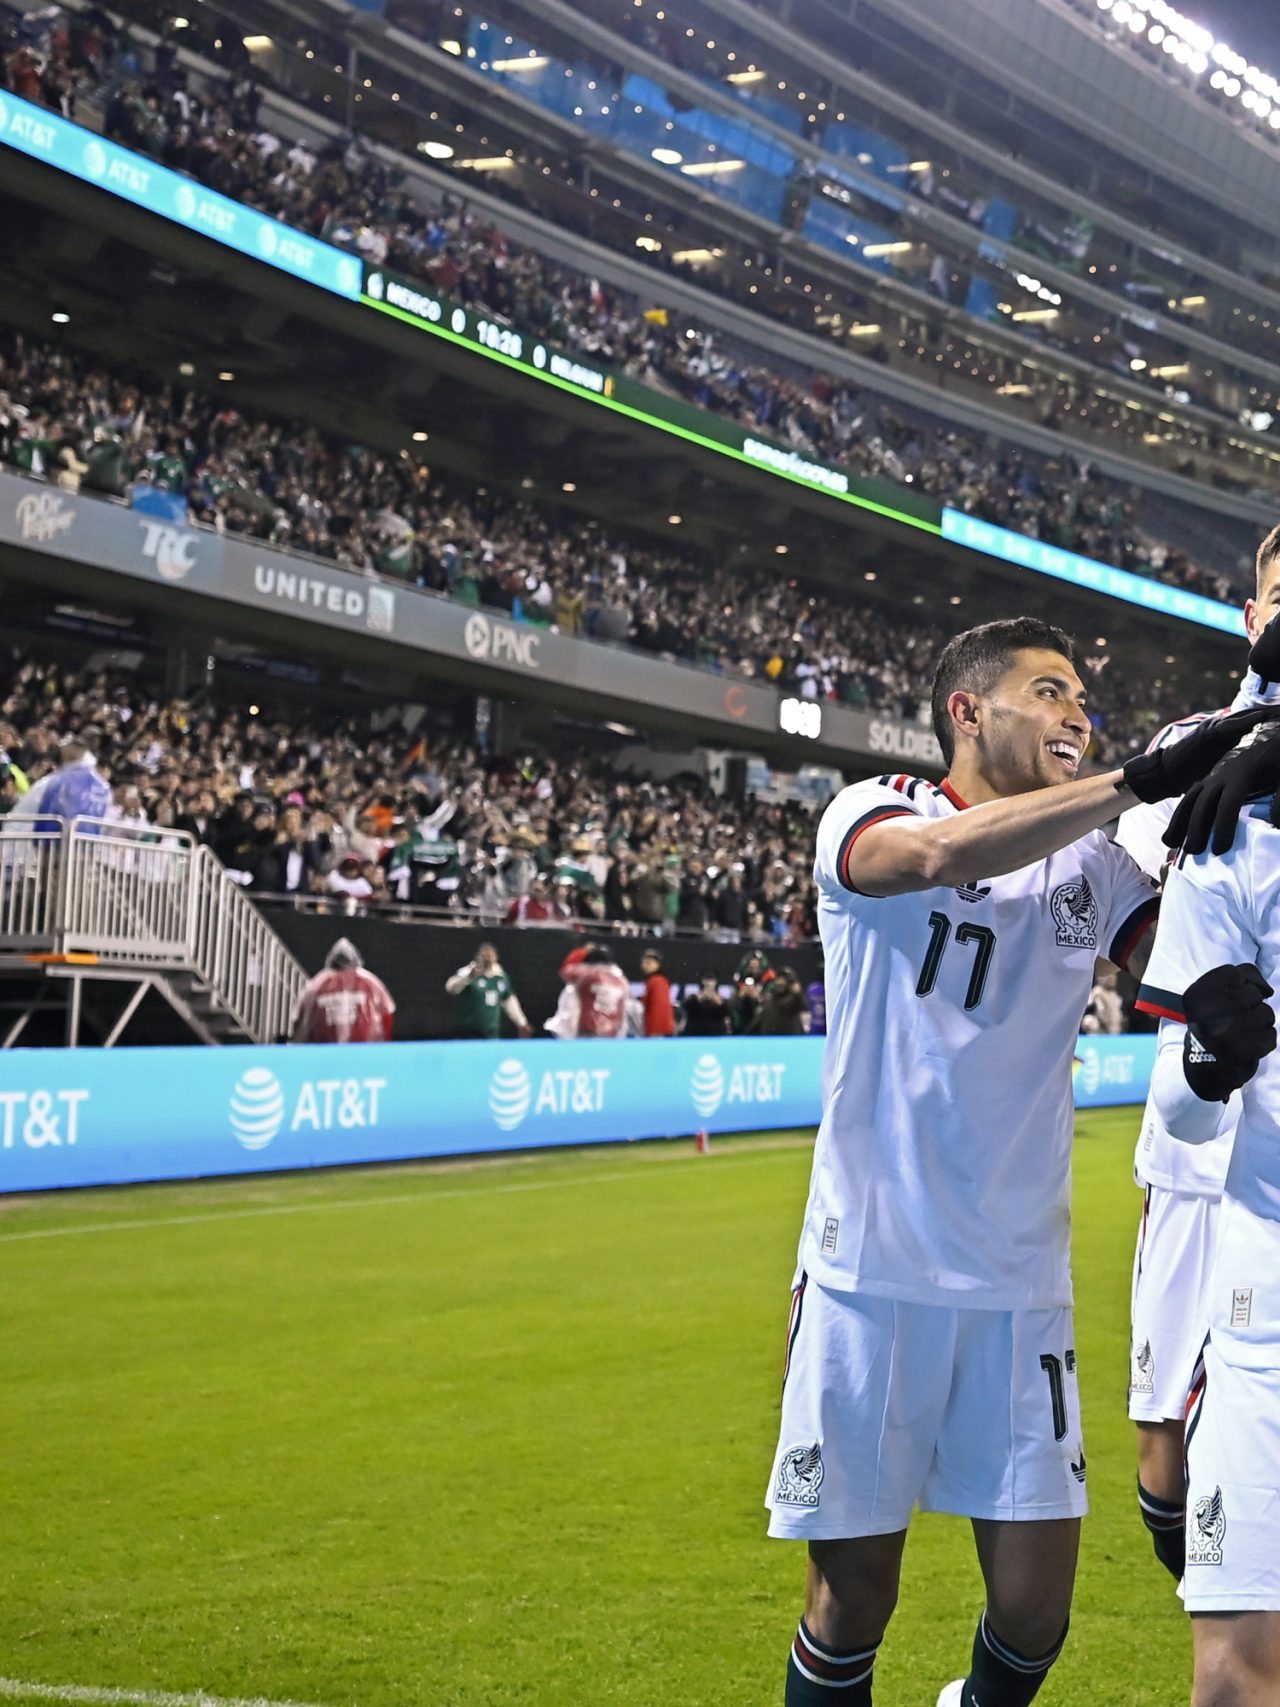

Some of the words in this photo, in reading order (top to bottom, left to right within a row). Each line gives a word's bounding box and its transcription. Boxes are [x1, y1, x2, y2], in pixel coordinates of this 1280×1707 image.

[9, 113, 57, 150] AT&T
[254, 564, 364, 617] UNITED
[492, 623, 541, 668] PNC
[915, 910, 997, 1012] 17
[1058, 932, 1095, 947] MÉXICO
[292, 1078, 387, 1131] AT&T
[535, 1069, 610, 1114] AT&T
[728, 1063, 786, 1103] AT&T
[777, 1490, 817, 1504] MÉXICO
